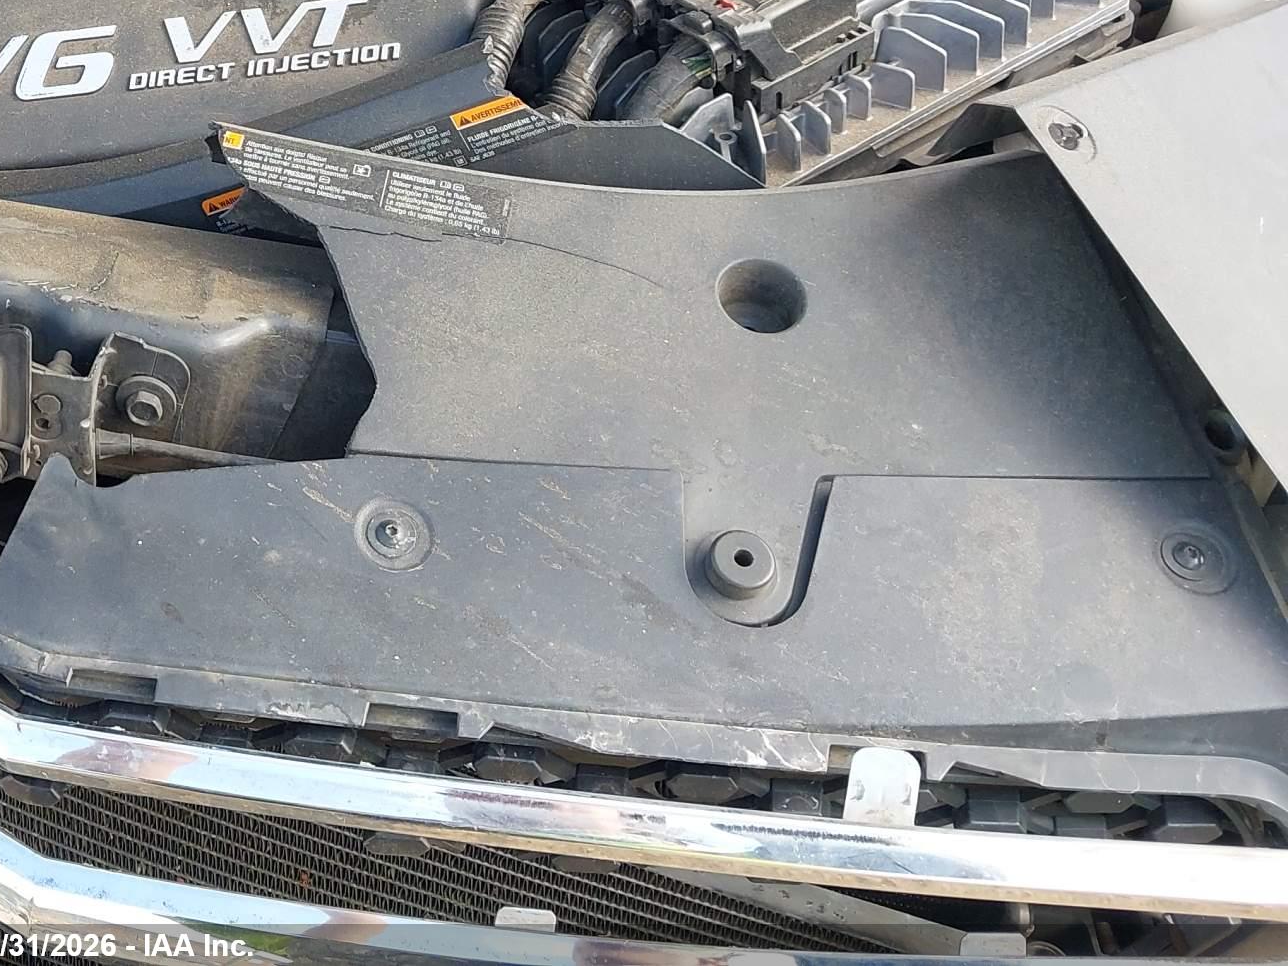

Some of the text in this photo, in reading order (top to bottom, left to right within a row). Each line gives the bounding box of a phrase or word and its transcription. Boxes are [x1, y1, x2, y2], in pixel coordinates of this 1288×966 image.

[128, 42, 401, 91] DIRECT INJECTION
[534, 119, 546, 127] doit
[370, 134, 413, 152] CONDITIONING
[467, 130, 489, 142] FLUIDE
[246, 140, 272, 150] Attention
[473, 145, 486, 154] Des
[243, 152, 262, 160] mettre
[269, 158, 290, 166] tourner
[293, 156, 324, 167] ventilateur
[324, 163, 339, 171] peut
[243, 160, 260, 168] SOUS
[261, 163, 282, 173] HAUTE
[283, 168, 315, 180] PRESSION
[257, 177, 282, 188] peuvent
[283, 183, 303, 191] causer
[287, 176, 317, 189] personnel
[392, 171, 435, 185] CLIMATISEUR
[390, 180, 411, 188] Utiliser
[412, 184, 445, 195] seulement
[453, 193, 470, 201] fluide
[384, 205, 406, 216] Charge
[421, 206, 447, 216] contient
